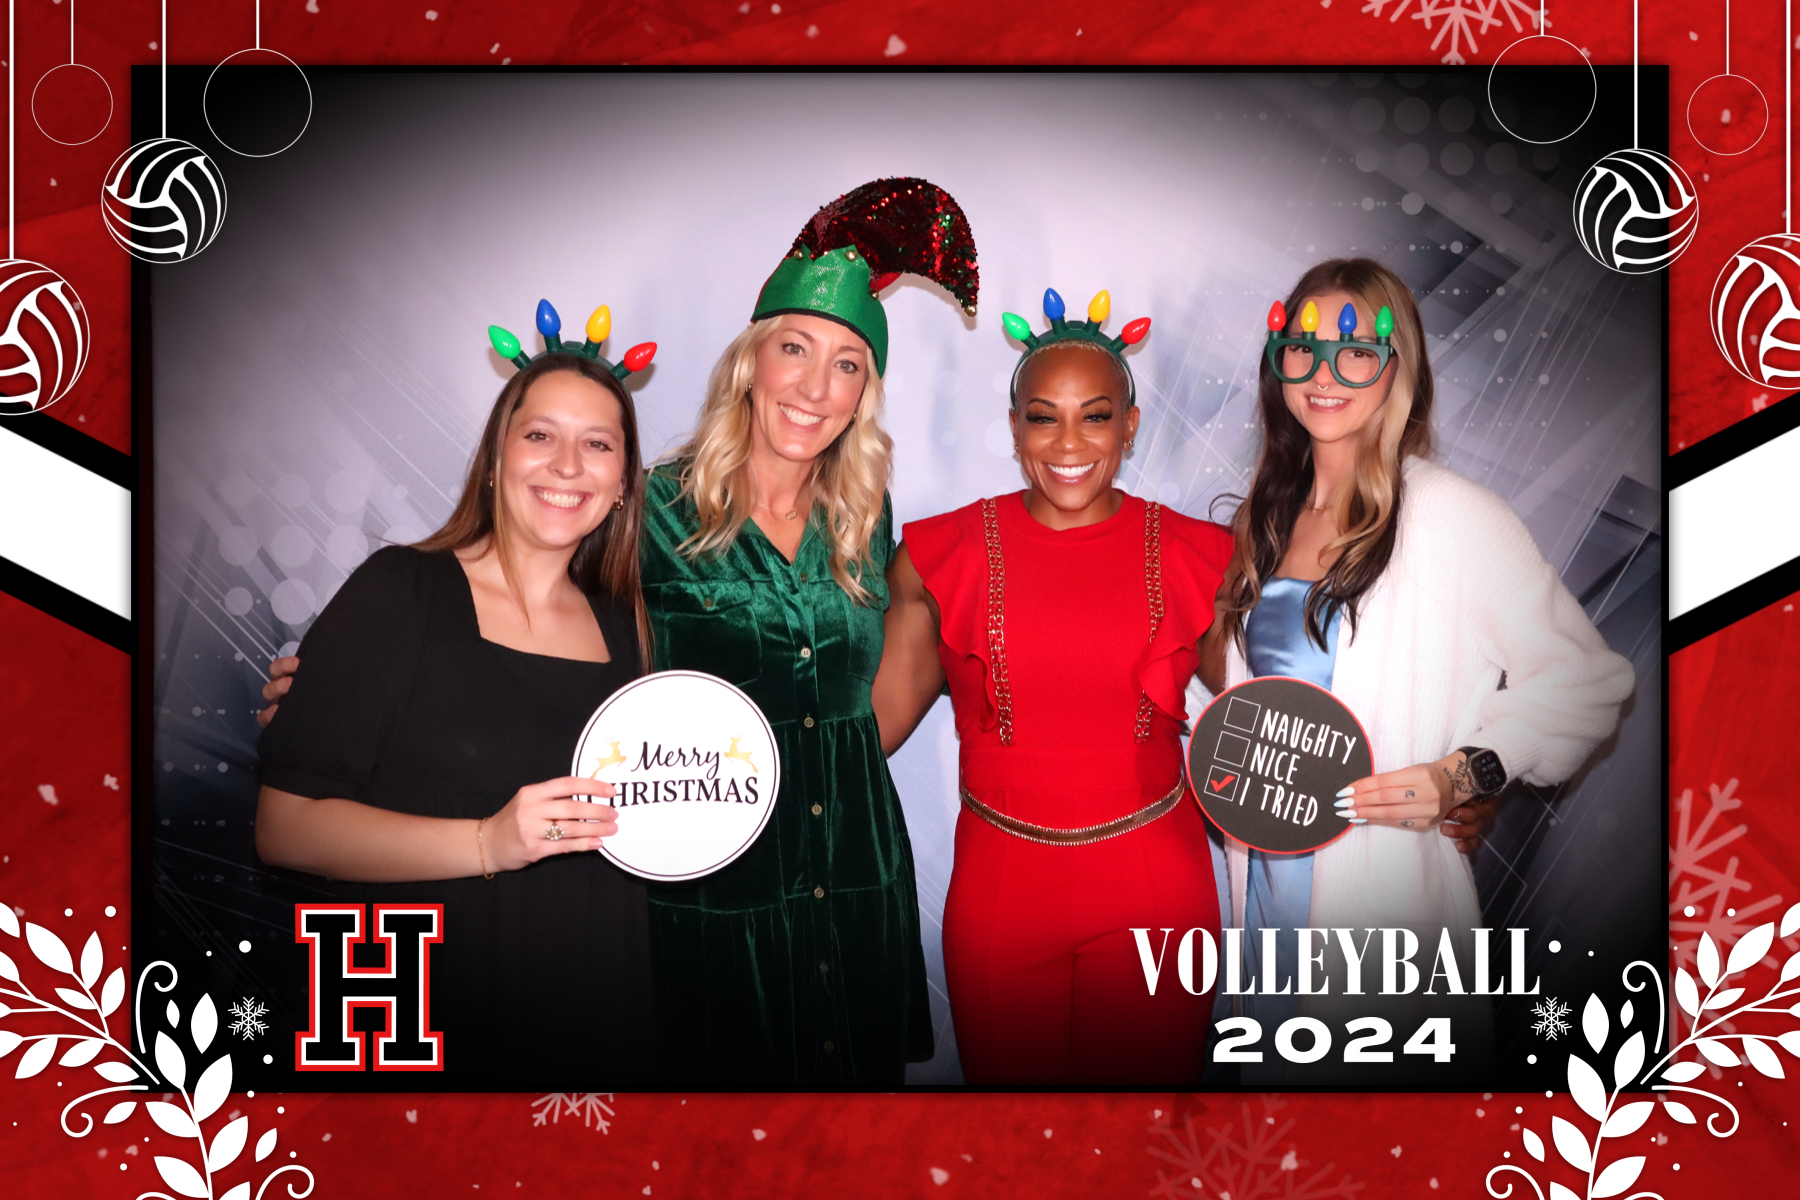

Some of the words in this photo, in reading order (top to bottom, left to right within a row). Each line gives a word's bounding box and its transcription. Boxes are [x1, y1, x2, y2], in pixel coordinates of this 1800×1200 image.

[1260, 708, 1357, 765] NAUGHTY
[630, 740, 720, 780] Merry
[1249, 743, 1300, 785] NICE
[587, 776, 759, 808] HRISTMAS
[1239, 777, 1251, 806] I
[1260, 784, 1319, 827] TRIED
